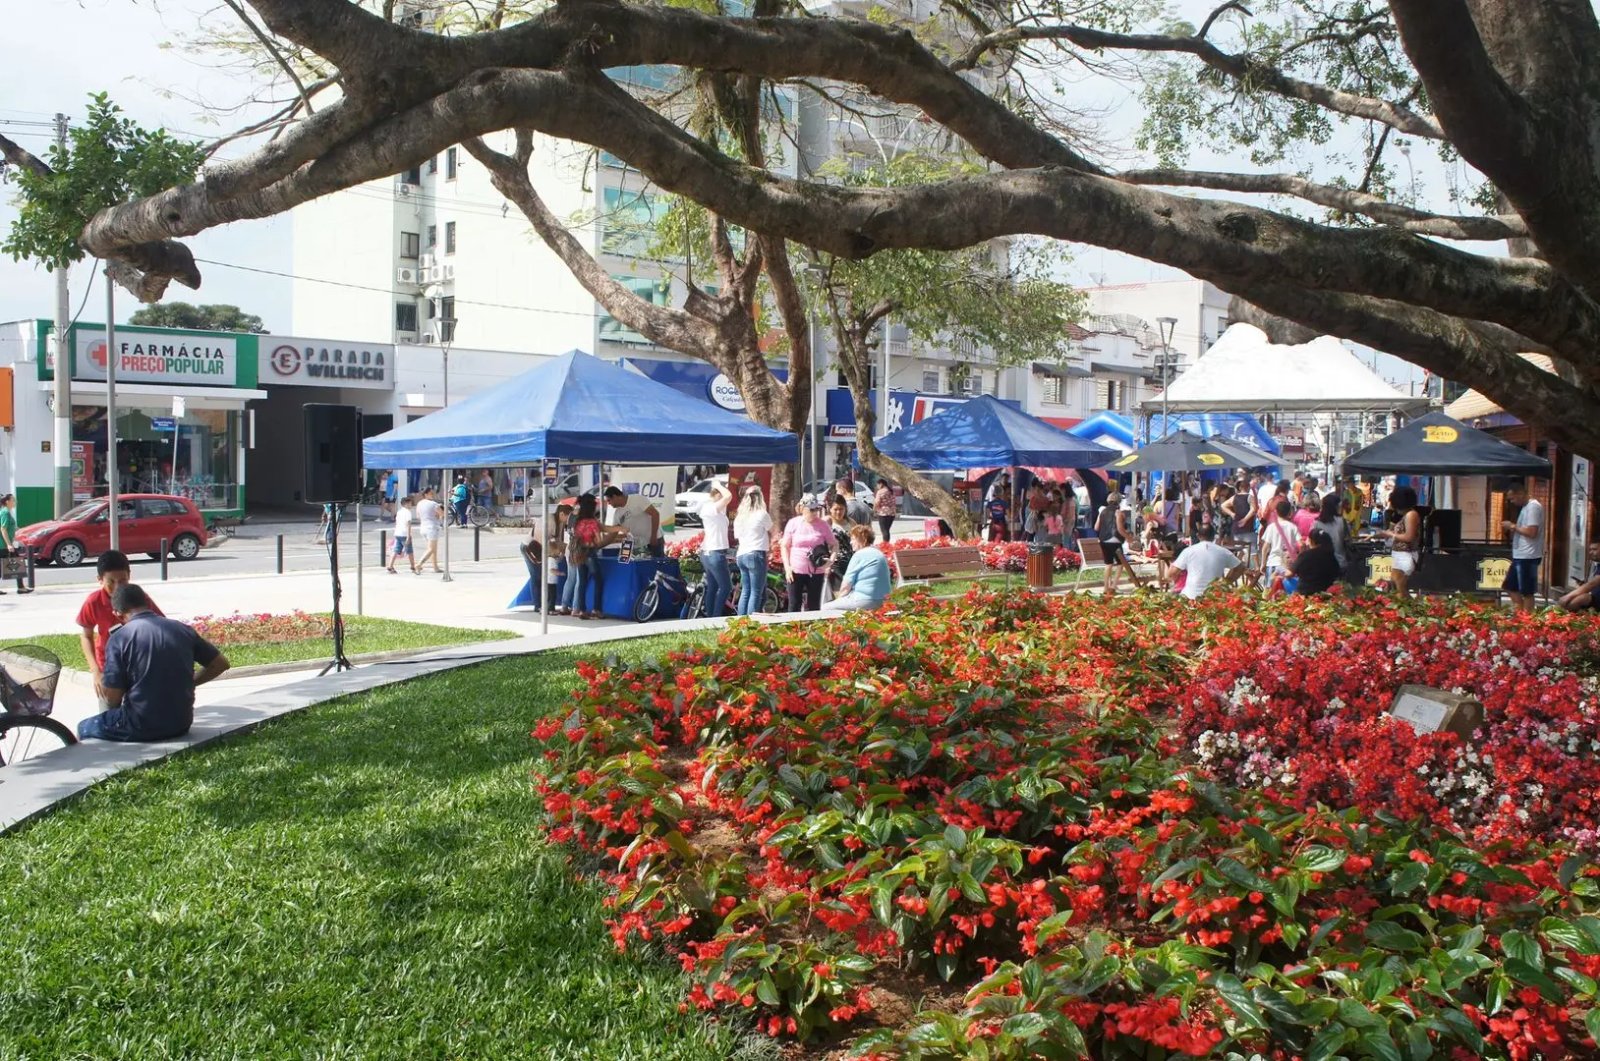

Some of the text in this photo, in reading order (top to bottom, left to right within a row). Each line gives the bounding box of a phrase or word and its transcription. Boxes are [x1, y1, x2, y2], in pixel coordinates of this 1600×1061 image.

[121, 343, 224, 359] FARMÁCIA
[305, 347, 384, 366] PARADA
[306, 364, 384, 381] WILLRICH
[641, 482, 664, 498] CDL
